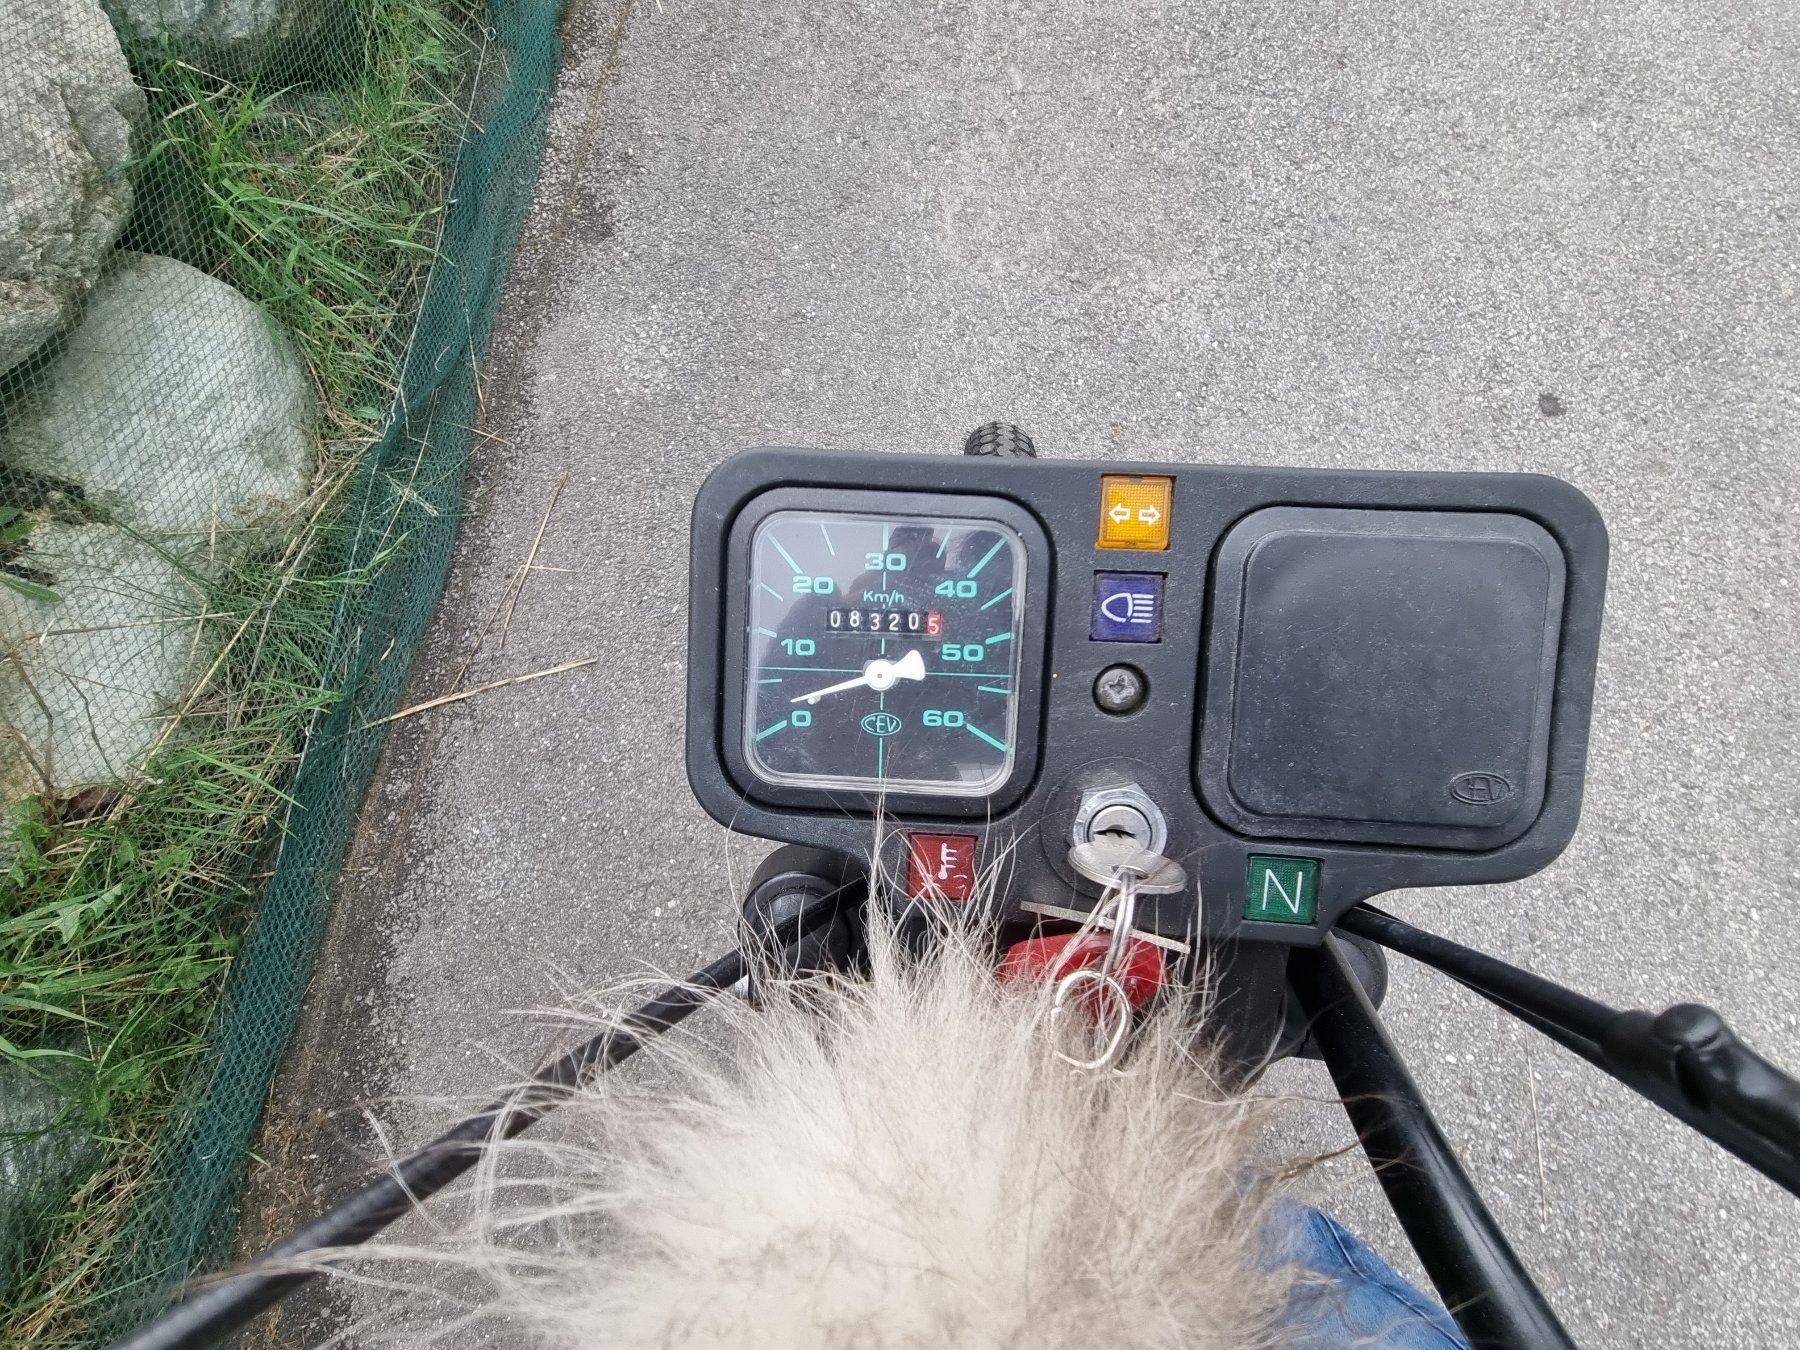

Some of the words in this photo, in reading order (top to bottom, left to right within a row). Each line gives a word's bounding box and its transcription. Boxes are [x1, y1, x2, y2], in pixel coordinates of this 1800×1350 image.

[864, 552, 907, 571] 30
[792, 576, 834, 595] 20
[934, 579, 978, 598] 40
[863, 589, 905, 607] Km/h
[780, 638, 816, 656] 10
[941, 643, 984, 662] 50
[791, 710, 812, 727] 0
[864, 715, 898, 733] CEV
[922, 709, 965, 727] 60
[1262, 868, 1303, 914] N
